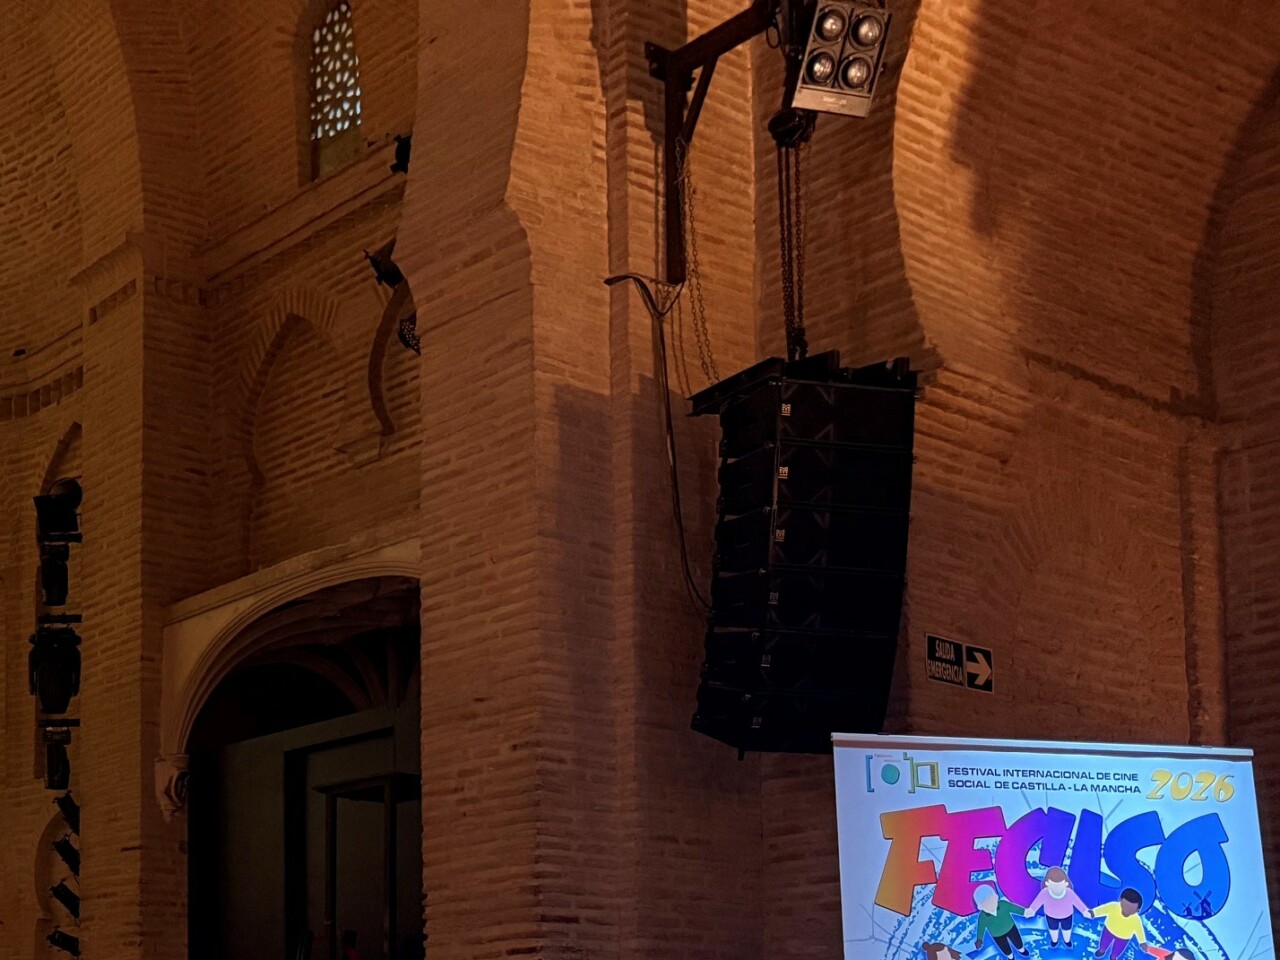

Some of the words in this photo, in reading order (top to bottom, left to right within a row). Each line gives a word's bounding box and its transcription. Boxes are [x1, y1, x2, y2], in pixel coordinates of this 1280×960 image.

[935, 640, 956, 662] SALIDA
[927, 660, 964, 682] EMERGENCIA
[947, 767, 1001, 777] FESTIVAL
[1003, 769, 1094, 781] INTERNACIONAL
[1096, 773, 1111, 781] DE
[1113, 773, 1138, 781] CINE
[948, 780, 991, 789] SOCIAL
[994, 781, 1010, 790] DE
[1012, 781, 1066, 792] CASTILLA
[1073, 784, 1088, 792] LA
[1091, 784, 1141, 794] MANCHA
[1146, 768, 1235, 803] 2026
[874, 804, 1231, 920] FECISO
